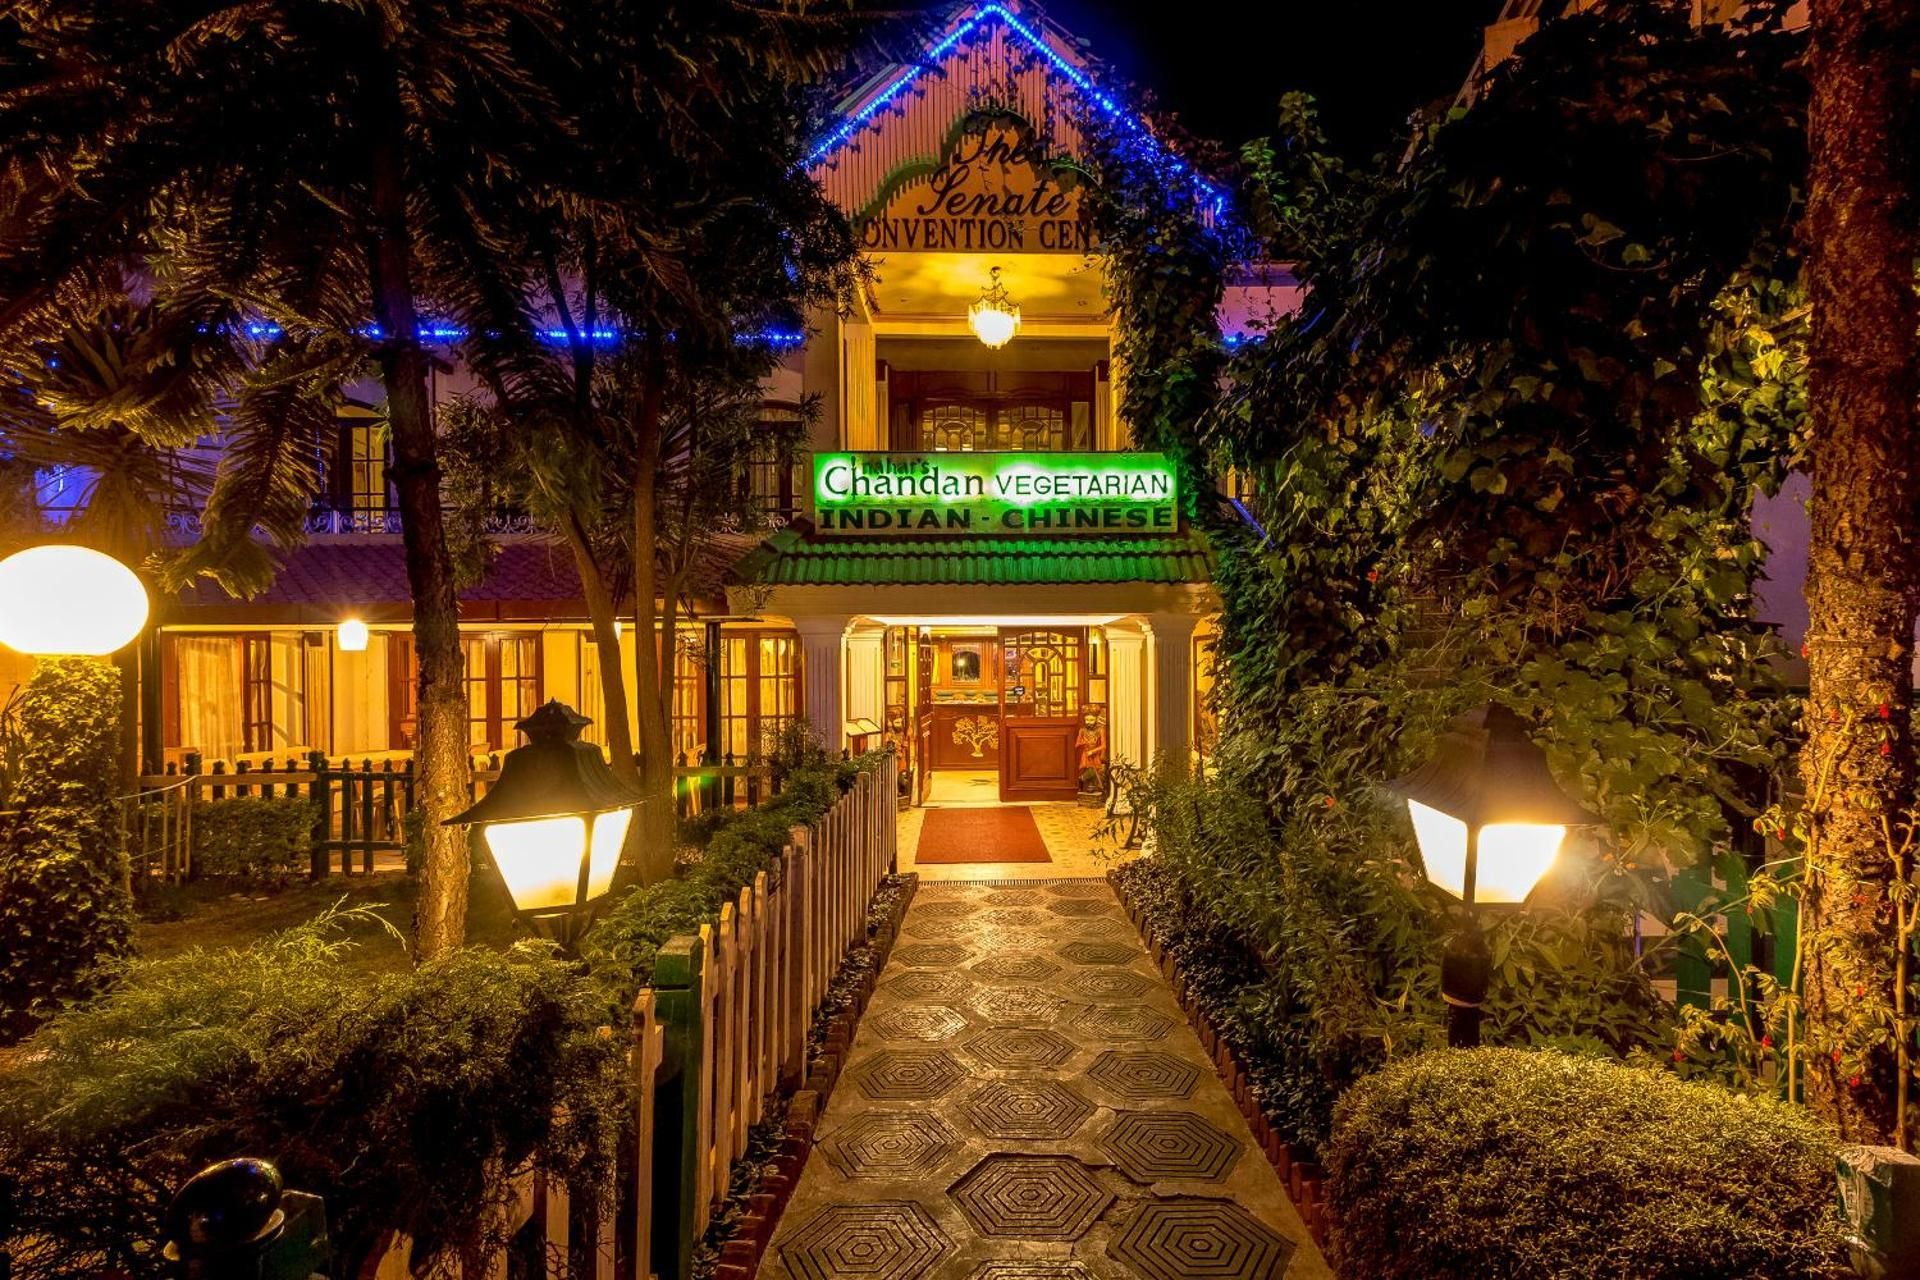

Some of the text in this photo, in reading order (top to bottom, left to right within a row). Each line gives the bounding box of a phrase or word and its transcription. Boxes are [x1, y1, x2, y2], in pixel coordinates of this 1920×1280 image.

[918, 166, 1070, 217] Senate
[863, 218, 1024, 250] ONVENTION
[824, 459, 1169, 497] Chandan VEGETARIAN
[819, 508, 971, 529] INDIAN
[1001, 506, 1173, 529] CHINESE
